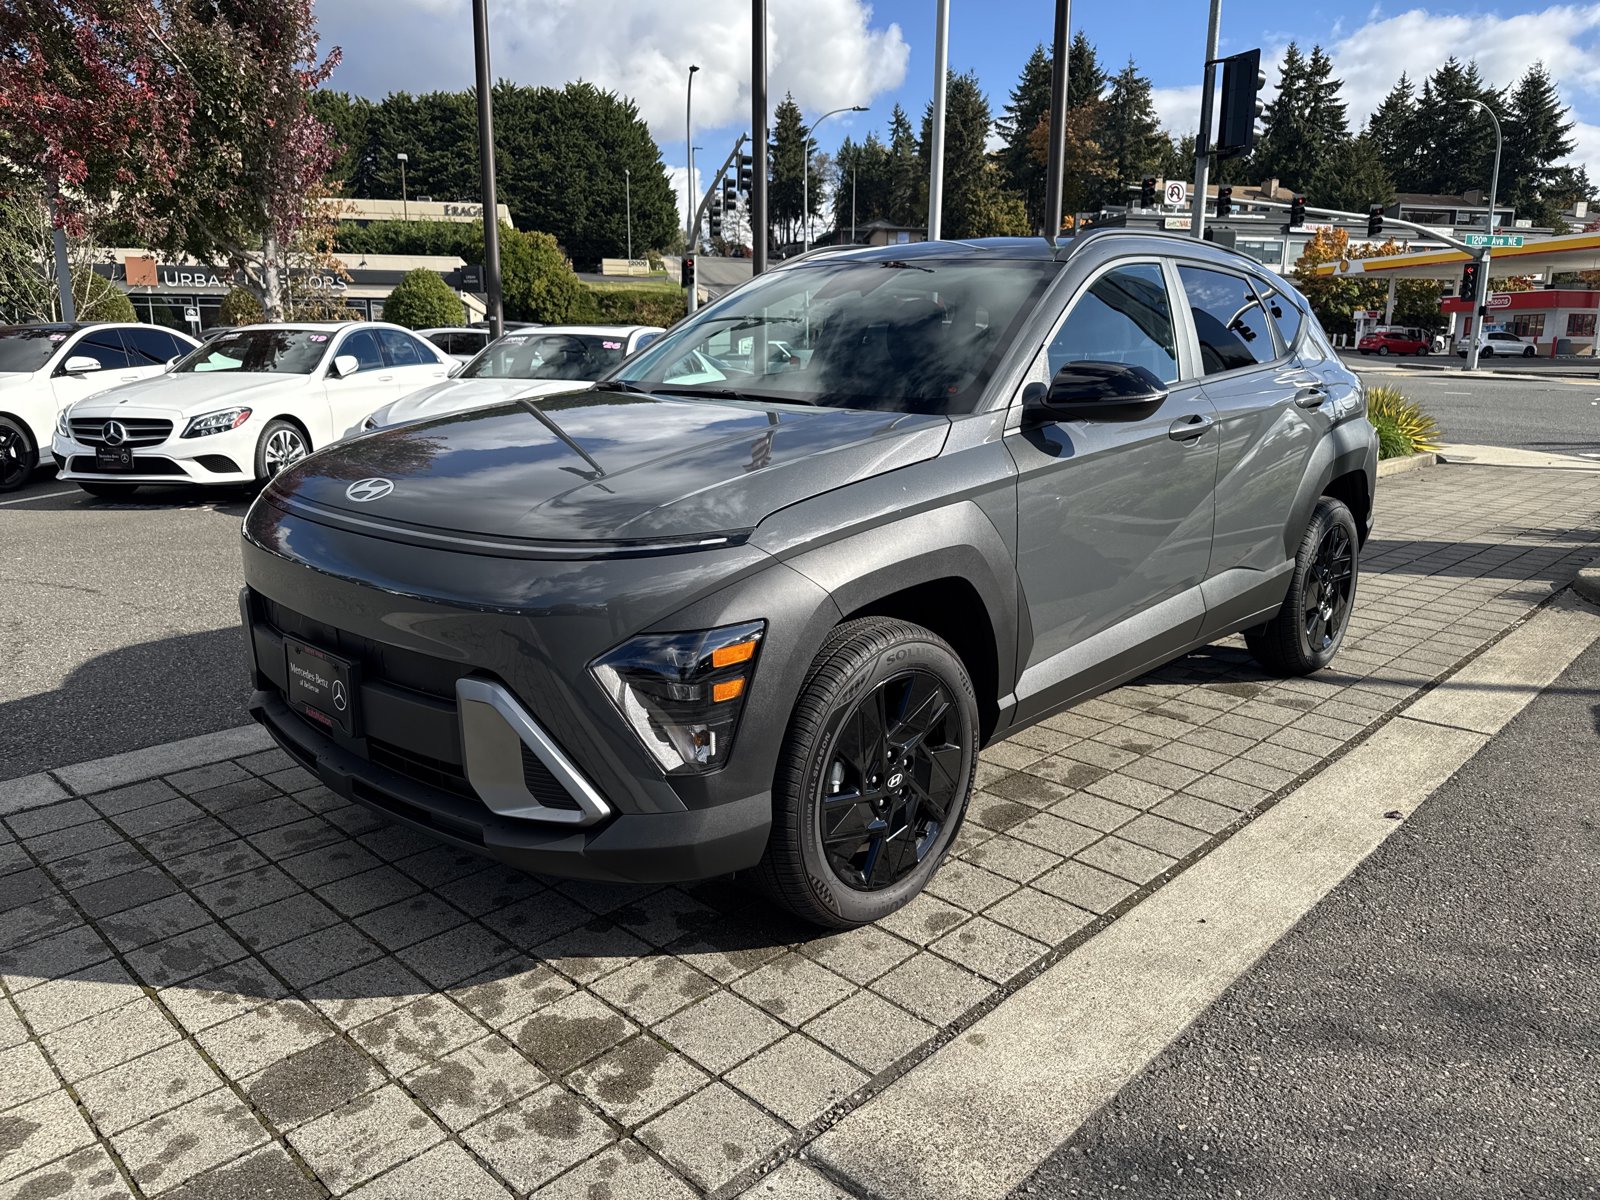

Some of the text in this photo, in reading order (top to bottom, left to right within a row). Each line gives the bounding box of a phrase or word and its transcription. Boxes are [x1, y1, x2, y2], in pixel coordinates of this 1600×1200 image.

[1471, 236, 1518, 246] 120th Ave NE
[164, 270, 229, 288] URBA
[886, 647, 935, 666] SOLUS
[290, 662, 328, 689] Mercedes-Benz
[806, 732, 831, 852] PREMIUM ALL-SEASON
